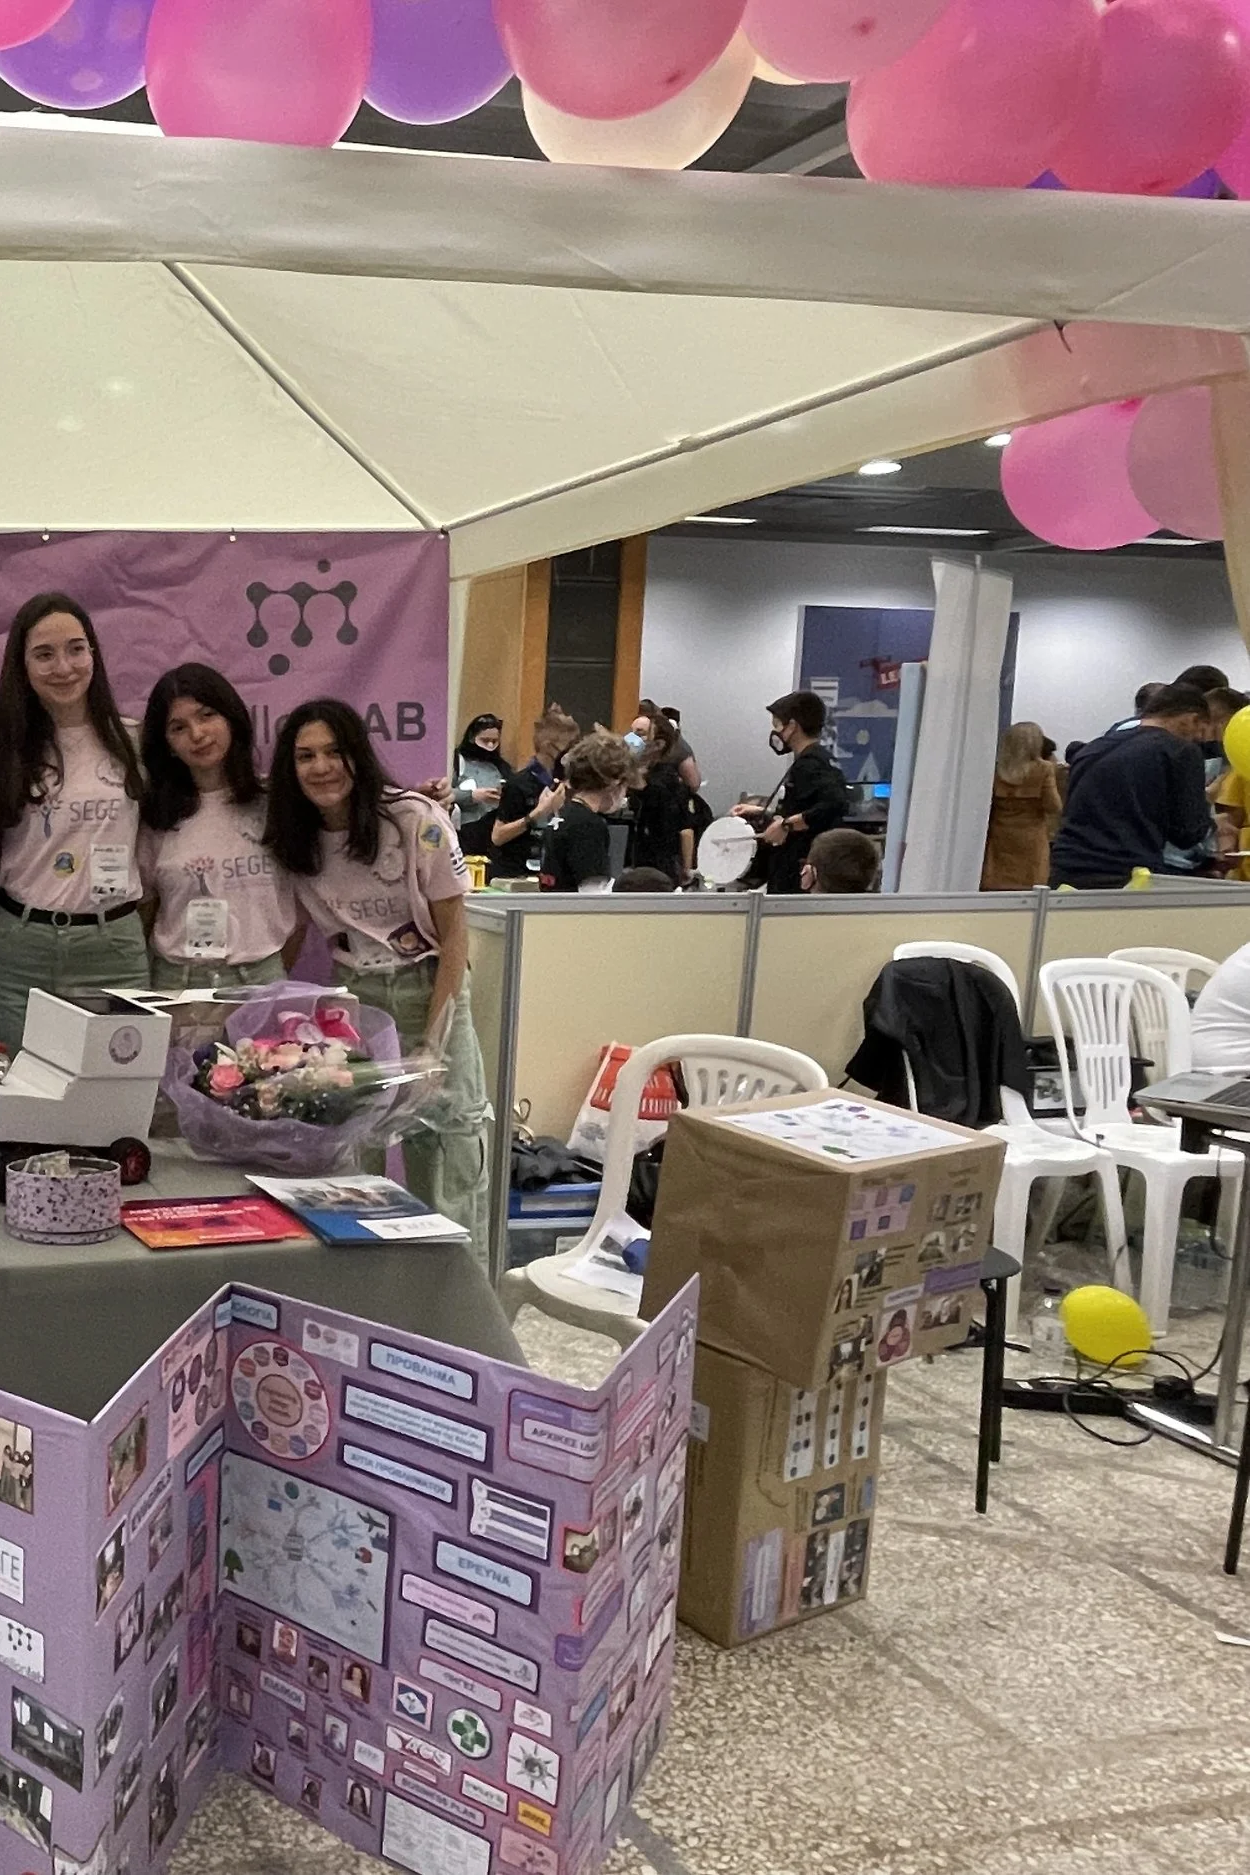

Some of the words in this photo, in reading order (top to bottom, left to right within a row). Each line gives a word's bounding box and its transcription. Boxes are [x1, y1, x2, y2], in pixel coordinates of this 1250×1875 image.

[70, 799, 120, 822] SEGE
[222, 854, 272, 879] SEGE
[350, 897, 401, 920] SEGE
[385, 1352, 457, 1386] ΠΡΟΒΛΗΜΑ
[457, 1556, 511, 1588] ΕΡΕΥΝΑ
